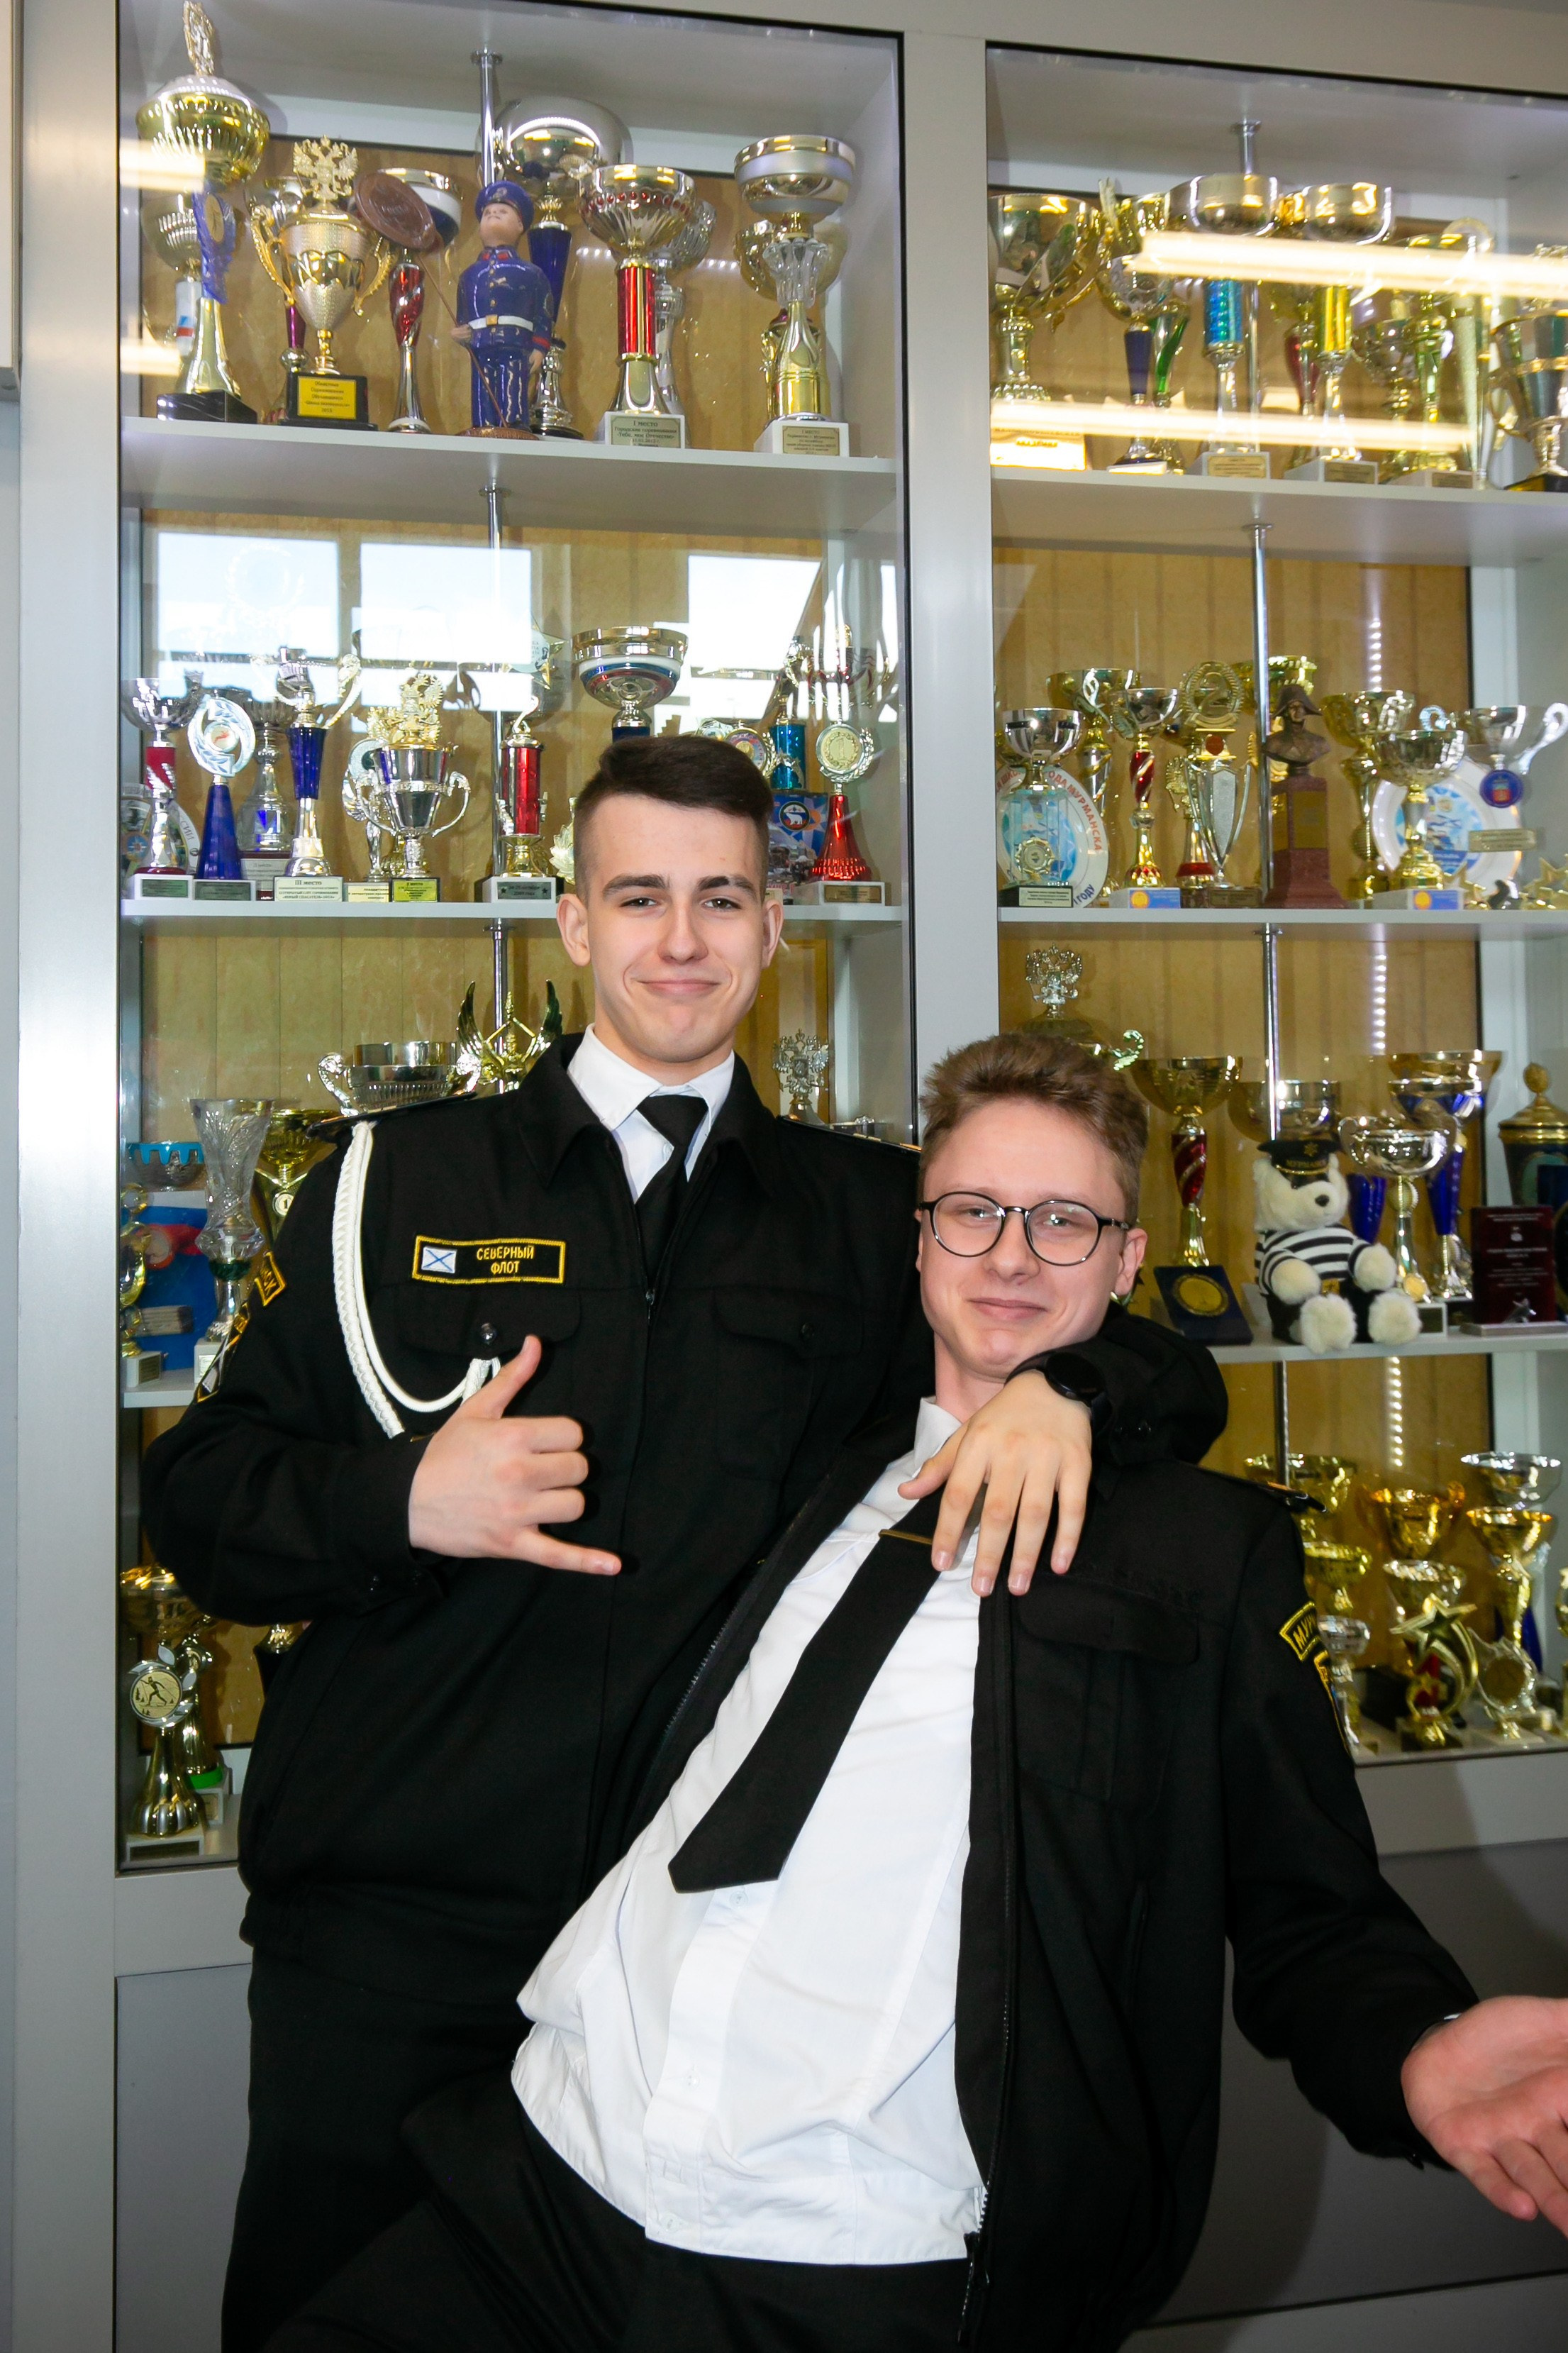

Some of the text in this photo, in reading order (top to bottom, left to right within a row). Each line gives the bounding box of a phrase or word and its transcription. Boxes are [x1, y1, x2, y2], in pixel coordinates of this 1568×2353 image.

[1067, 784, 1102, 851] МУРМАНСКА
[1076, 884, 1095, 903] ГОДУ
[477, 1244, 535, 1261] СЕВЕРНЫЙ
[490, 1261, 521, 1275] ФЛОТ
